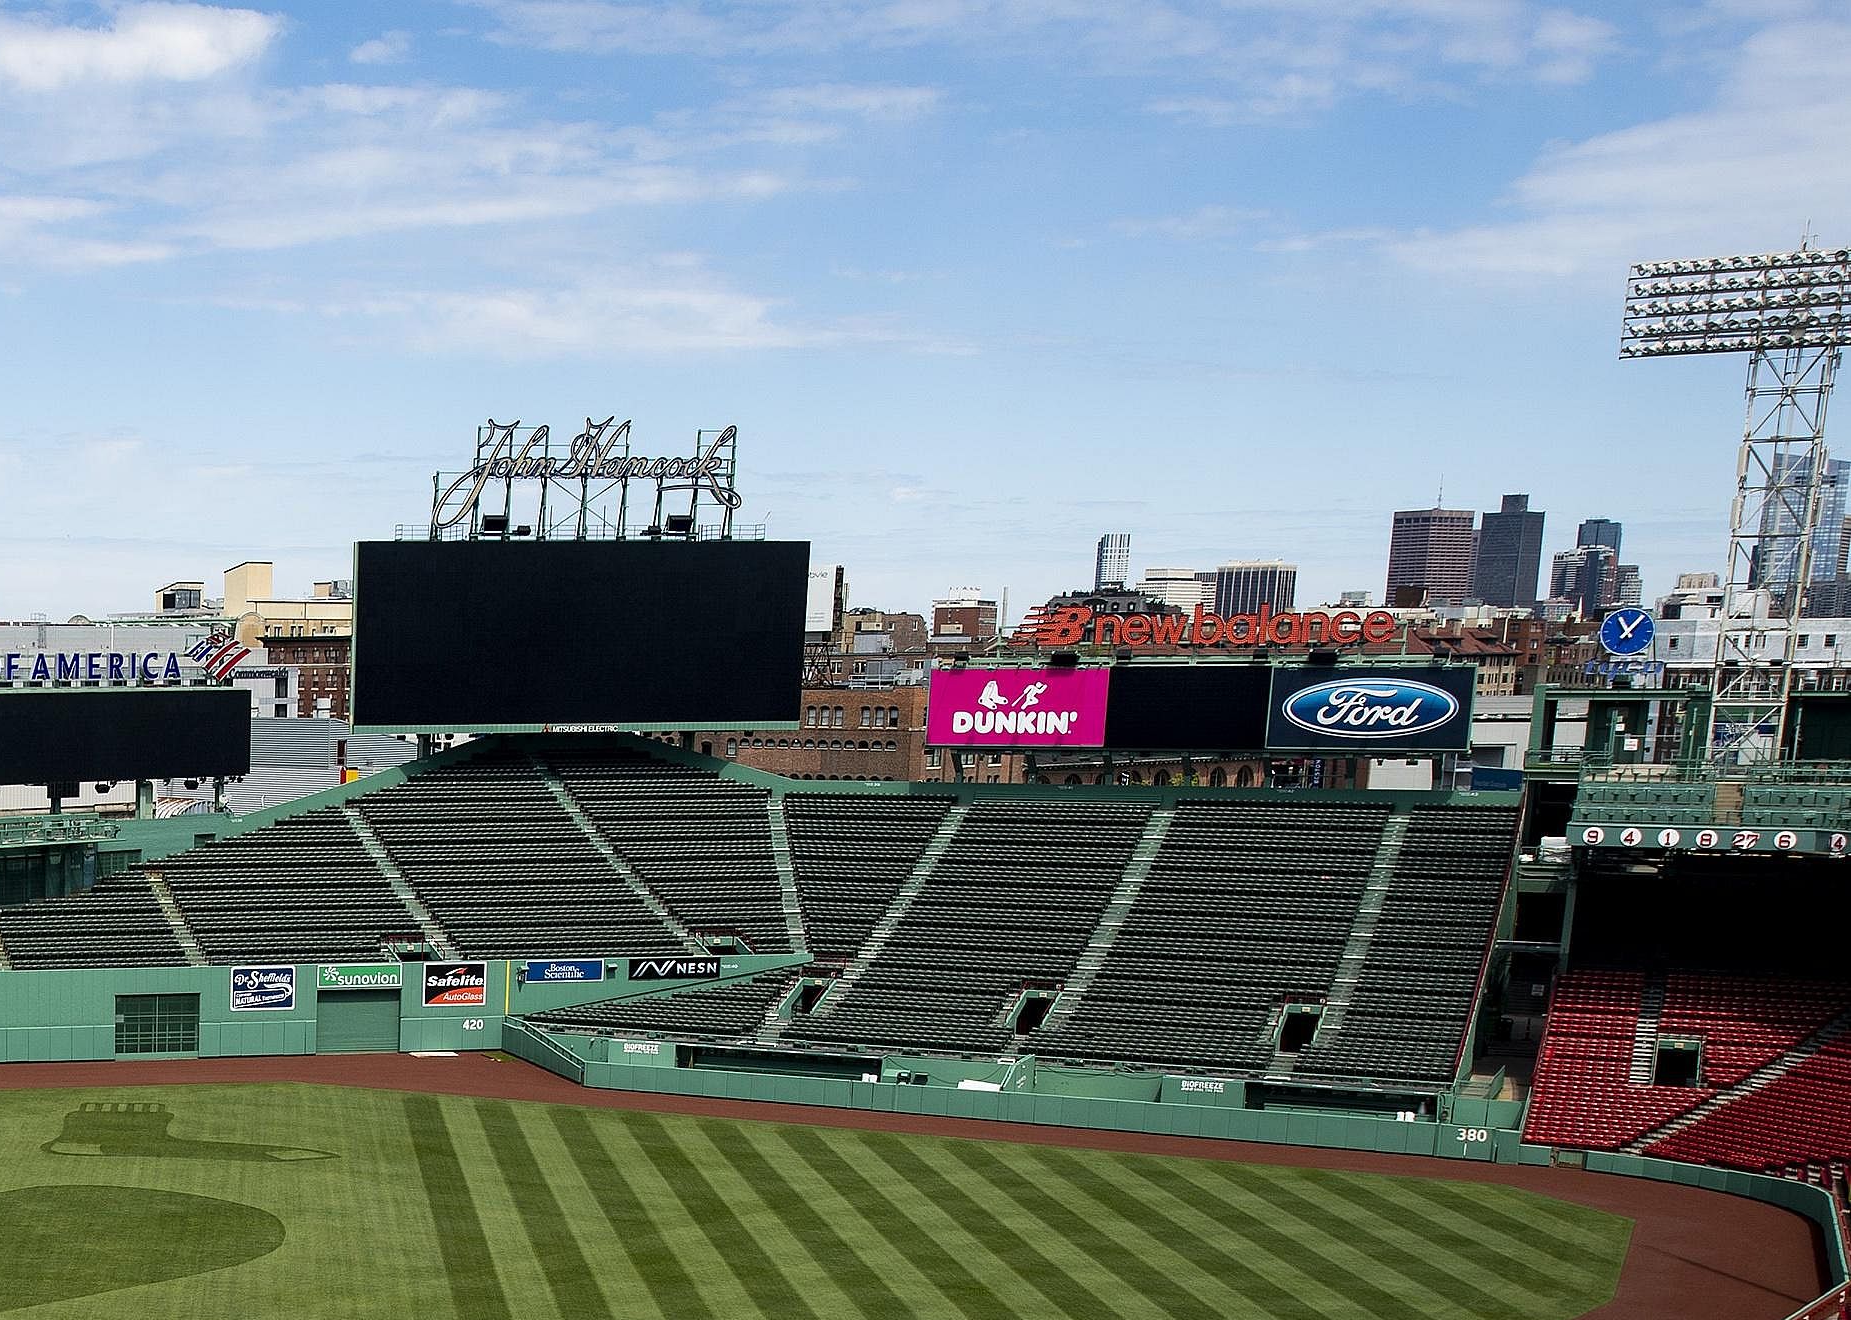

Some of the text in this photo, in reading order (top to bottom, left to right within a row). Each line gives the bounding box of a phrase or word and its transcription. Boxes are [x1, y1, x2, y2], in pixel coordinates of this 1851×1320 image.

[559, 415, 741, 509] Hancock
[1095, 614, 1185, 646] new
[1190, 604, 1398, 646] balance
[31, 651, 182, 682] AMERICA
[1317, 687, 1422, 727] Ford
[552, 725, 619, 733] MITSUBISHI ELECTRIC
[952, 710, 1078, 735] DUNKIN'
[1587, 829, 1599, 843] 9
[1624, 830, 1635, 845] 4
[1664, 831, 1673, 845] 1
[1700, 832, 1713, 846] 8
[1732, 833, 1760, 849] 27
[1778, 834, 1792, 848] 6
[544, 968, 585, 979] Scientific
[551, 963, 576, 972] Boston
[676, 962, 718, 974] NESN
[337, 971, 398, 985] sunovion
[427, 974, 484, 987] Safelite
[442, 992, 484, 1002] AutoGlass
[462, 1019, 484, 1030] 420
[1456, 1127, 1488, 1143] 380
